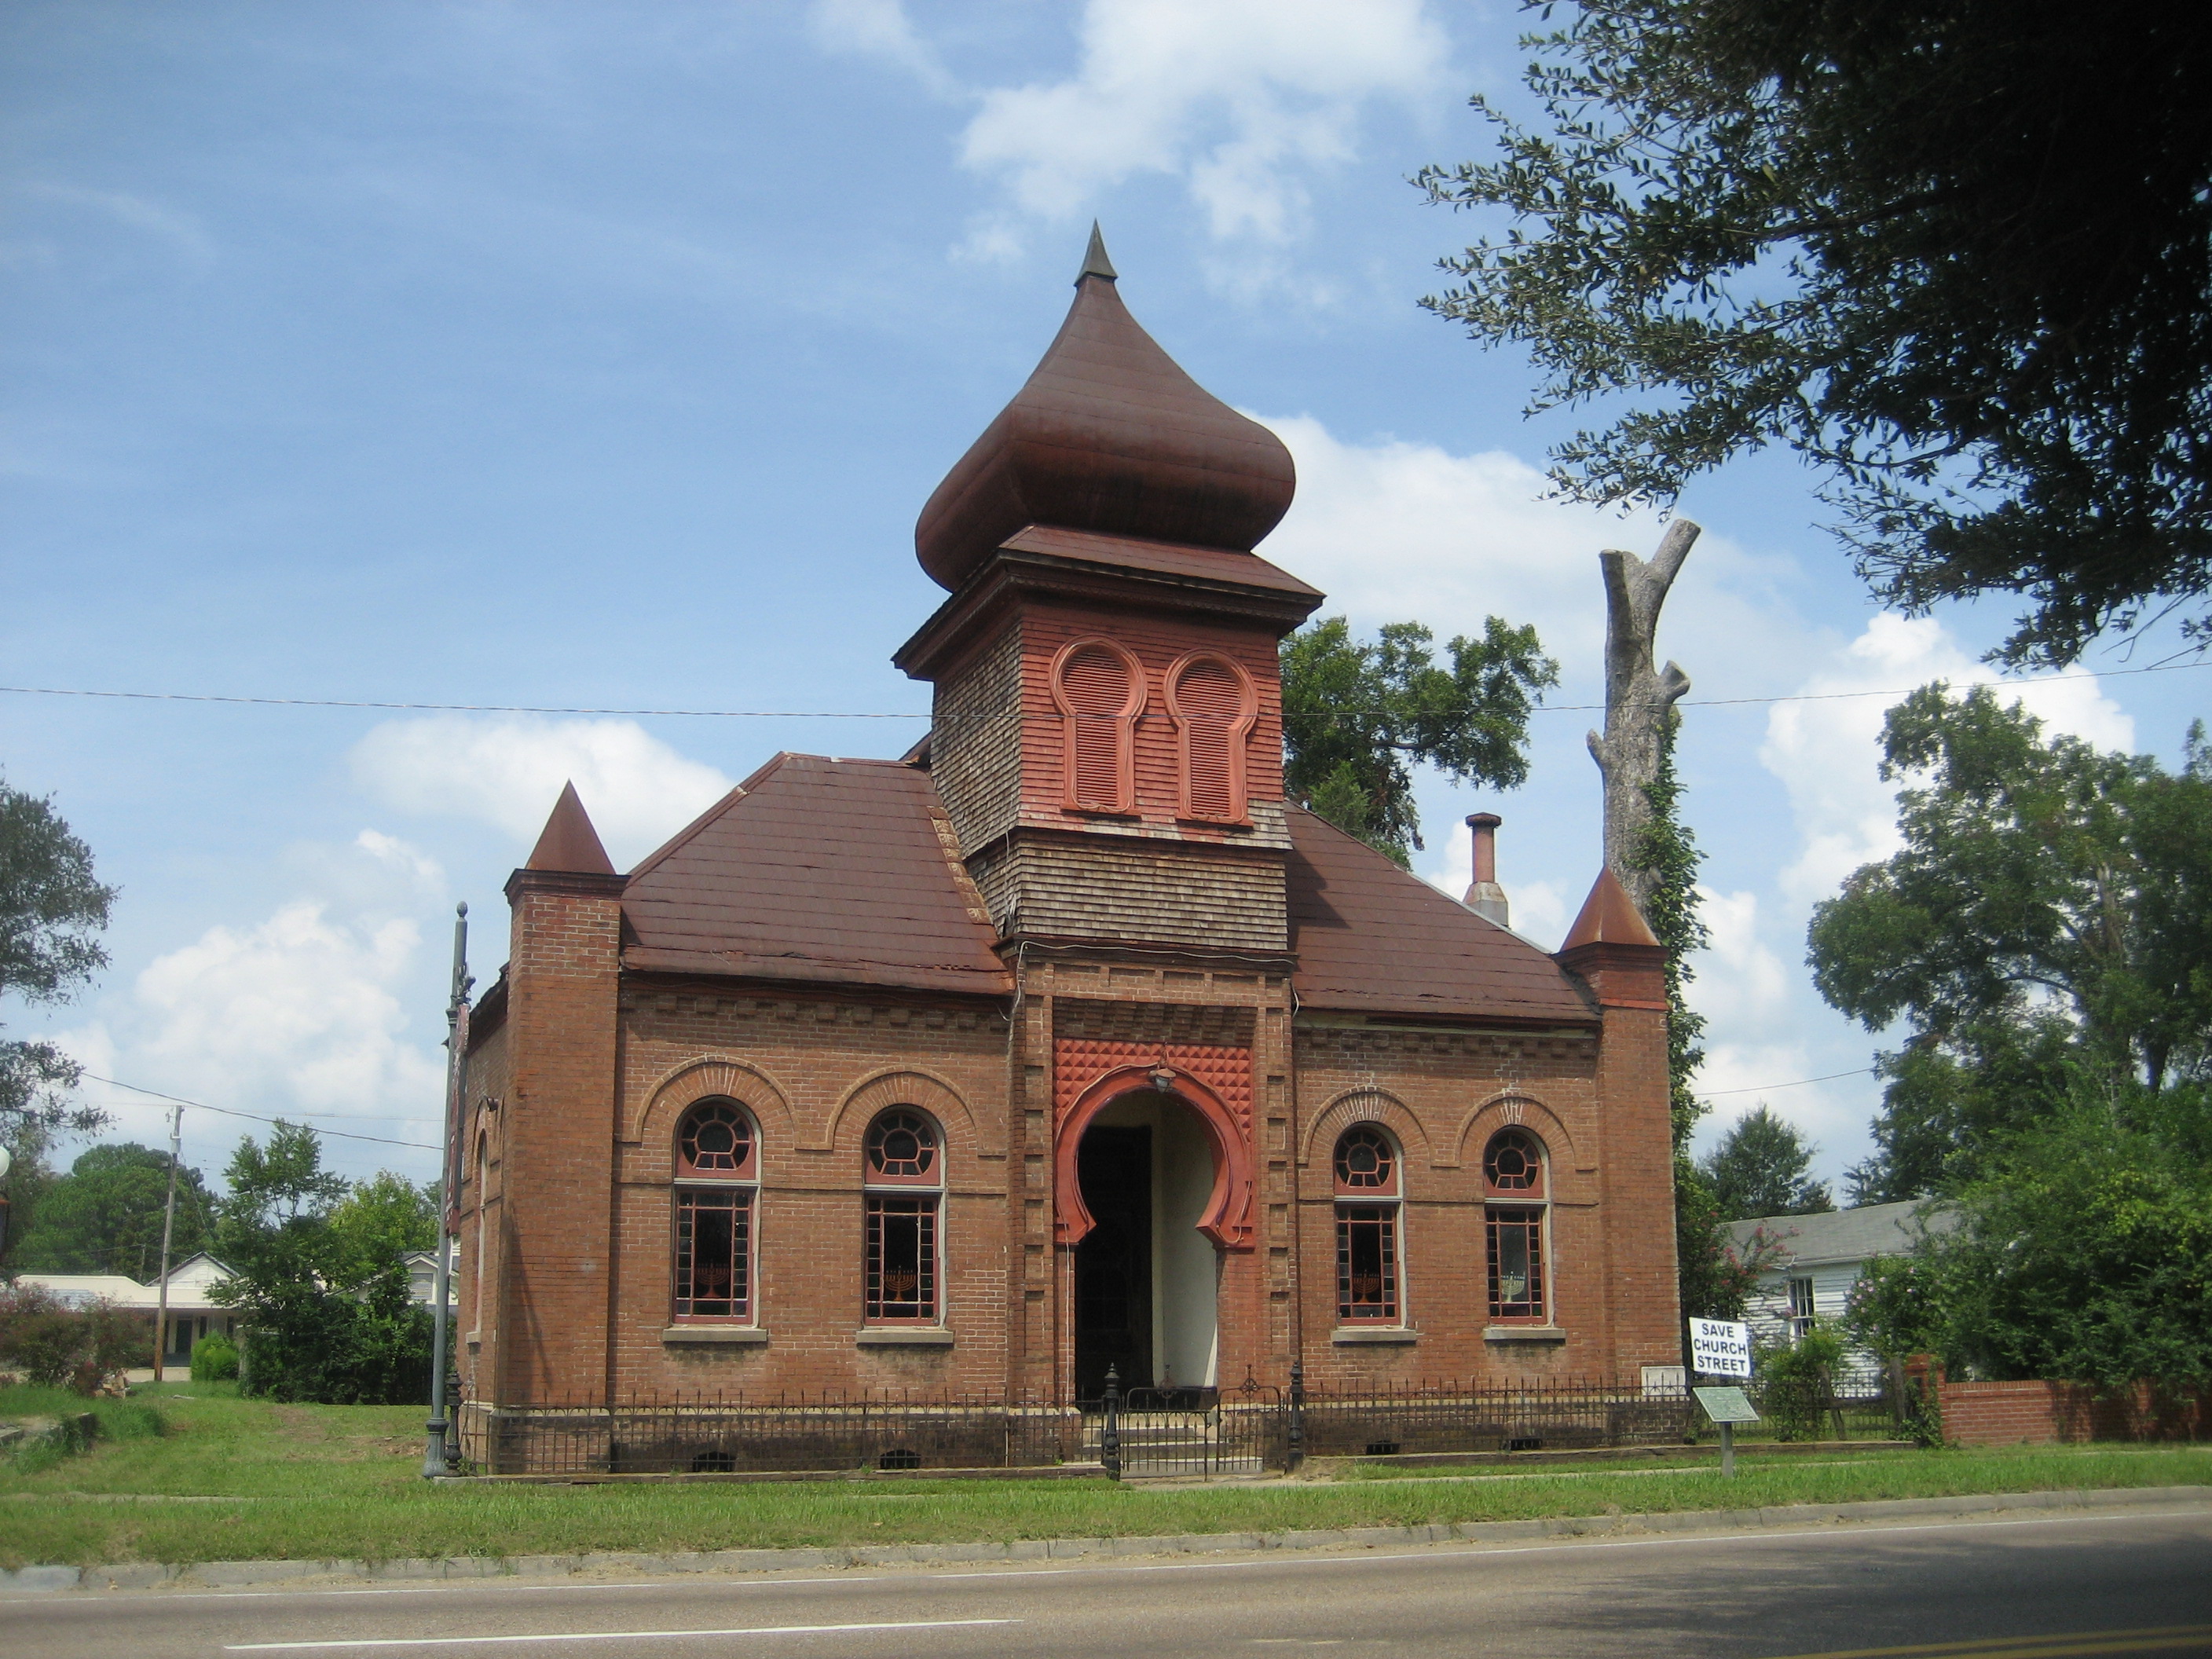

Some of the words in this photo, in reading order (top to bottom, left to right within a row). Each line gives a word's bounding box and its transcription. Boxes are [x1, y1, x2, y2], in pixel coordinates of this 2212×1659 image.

[1701, 1323, 1734, 1338] SAVE
[1694, 1339, 1746, 1355] CHURCH
[1697, 1355, 1745, 1372] STREET
